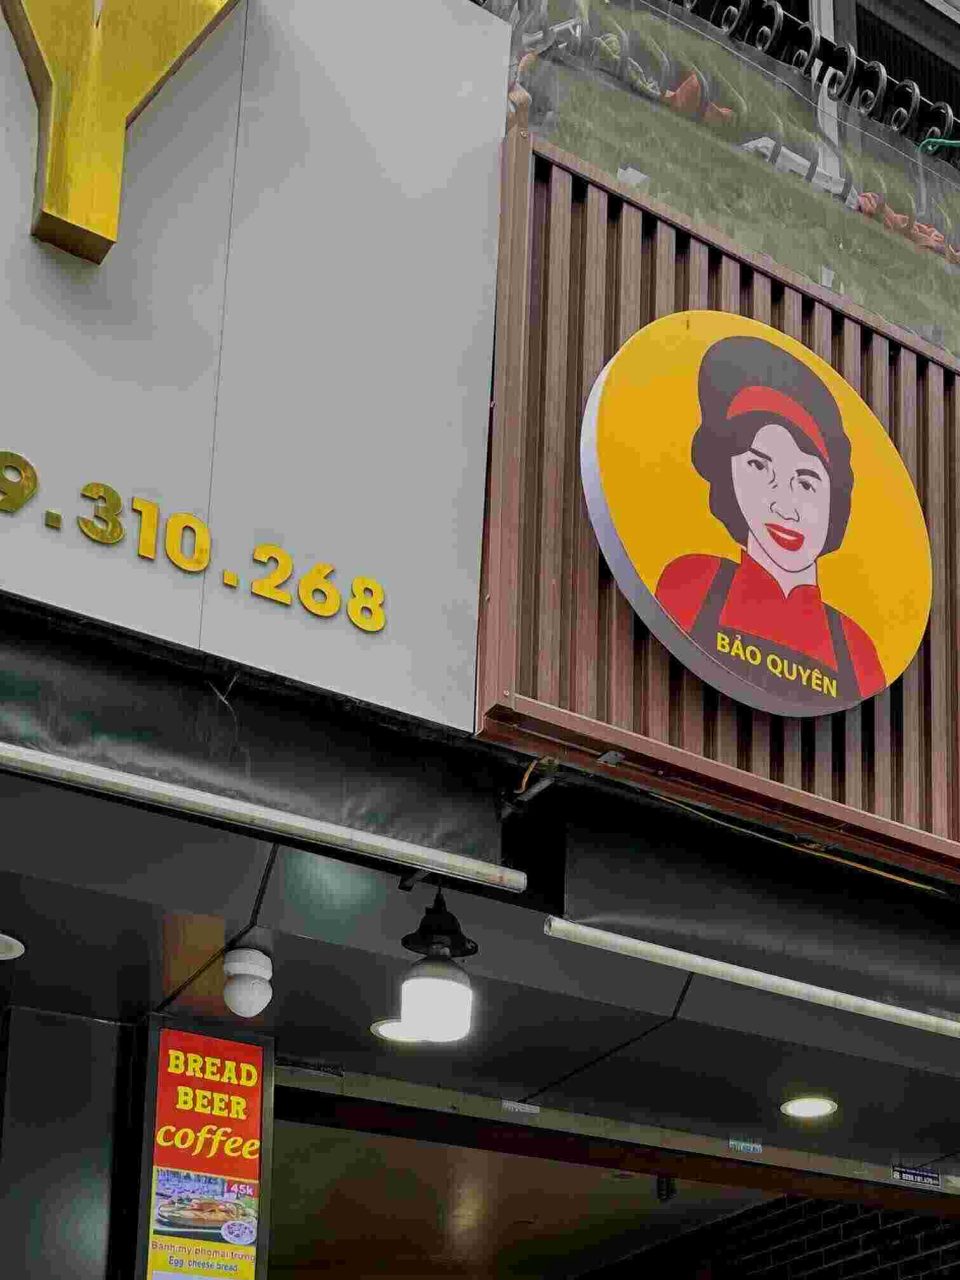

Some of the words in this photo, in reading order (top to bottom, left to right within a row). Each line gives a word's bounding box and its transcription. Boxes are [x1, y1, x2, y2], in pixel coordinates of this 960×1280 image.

[716, 632, 762, 666] BẢO
[766, 654, 837, 698] QUYÊN
[168, 1049, 258, 1087] BREAD
[176, 1086, 247, 1120] BEER
[156, 1125, 260, 1159] coffee
[231, 1184, 254, 1196] 45k
